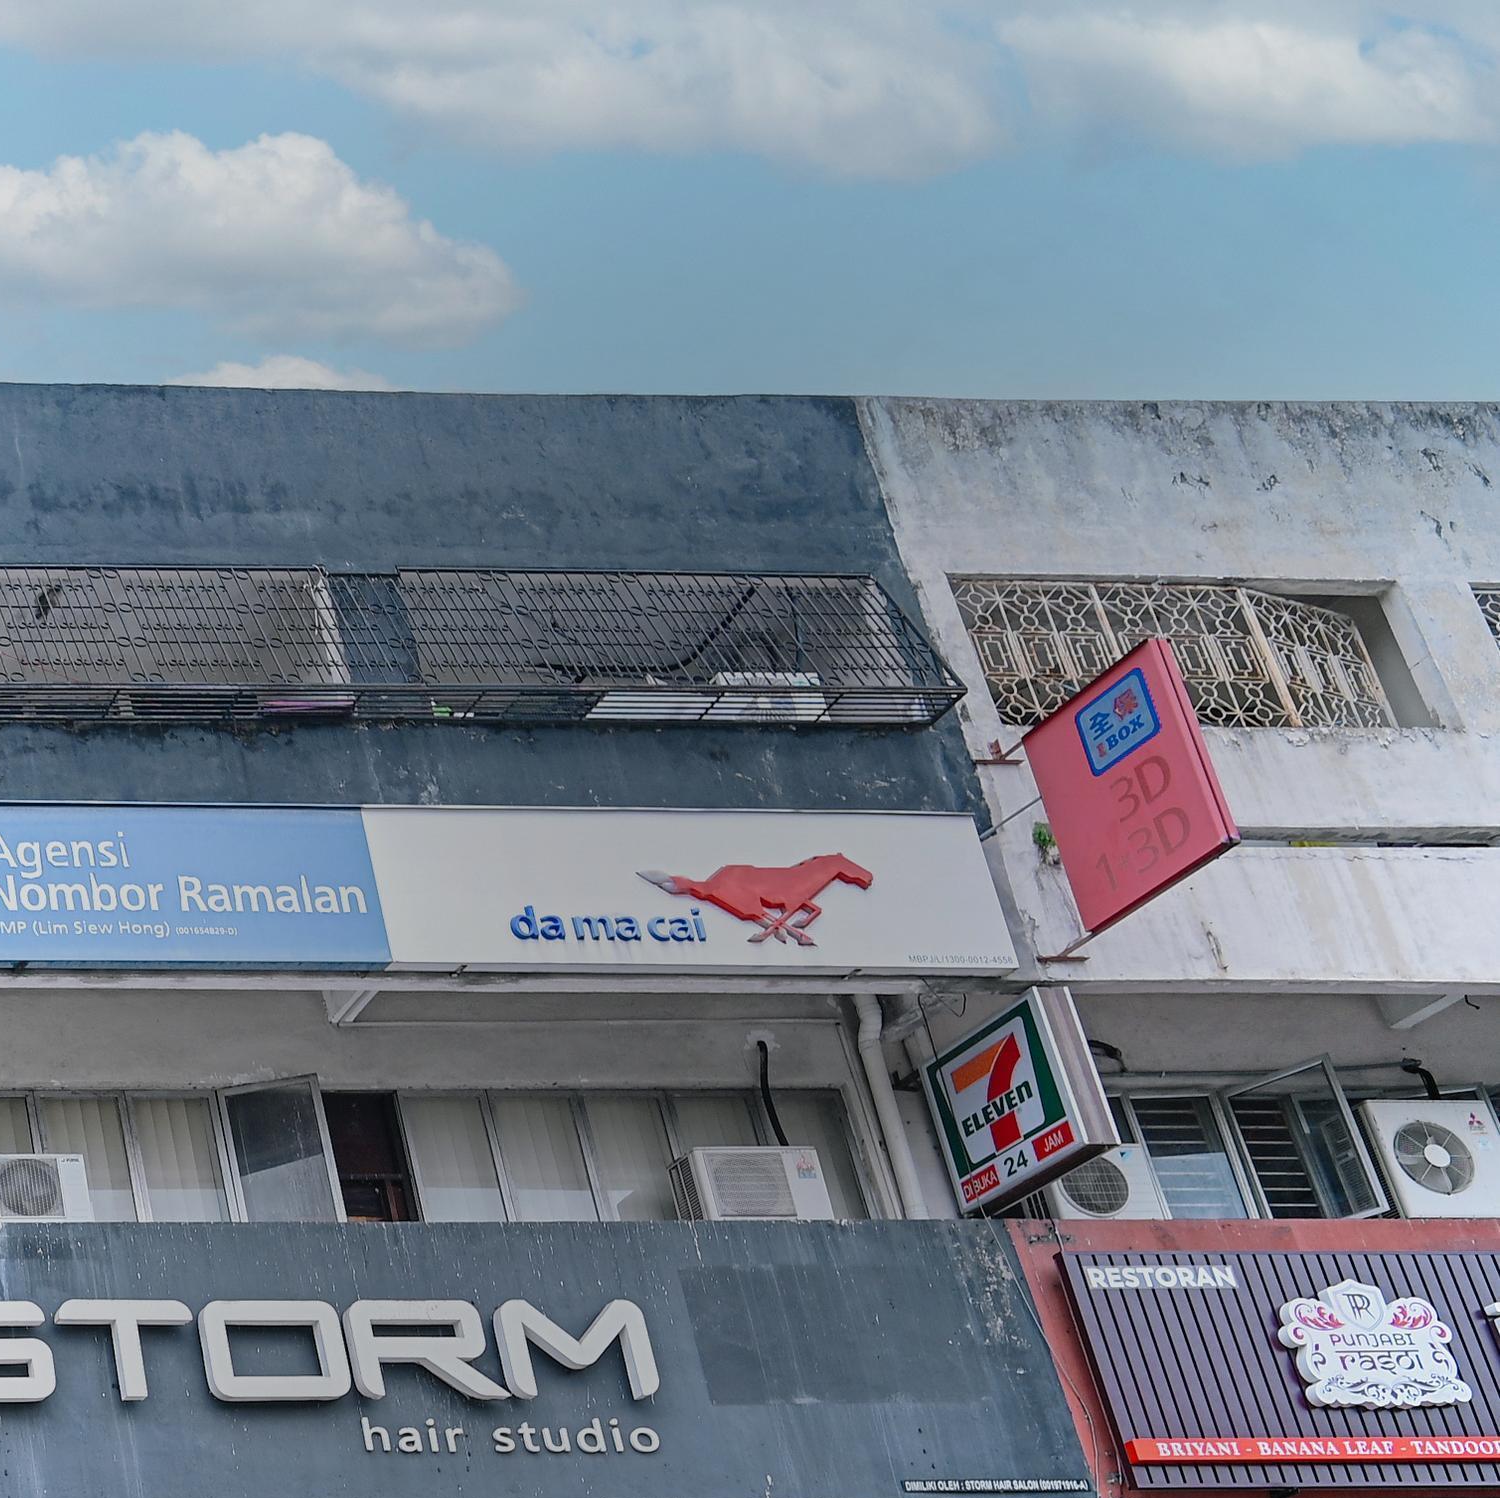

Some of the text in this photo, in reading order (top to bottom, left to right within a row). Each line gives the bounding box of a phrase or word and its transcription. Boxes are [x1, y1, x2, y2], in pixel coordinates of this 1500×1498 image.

[1110, 755, 1171, 823] 3D
[178, 875, 368, 914] Ramalan
[33, 921, 71, 938] (Lim
[74, 920, 114, 936] Siew
[120, 919, 171, 938] Hong)
[1003, 1149, 1029, 1178] 24
[1043, 1131, 1064, 1153] JAM
[1086, 1265, 1238, 1290] RESTORAN
[1329, 1332, 1416, 1348] PUNJABI
[361, 1416, 662, 1454] hair studio
[1156, 1441, 1241, 1457] BRIYANI
[1258, 1441, 1338, 1456] BANANA
[1342, 1440, 1394, 1455] LEAF
[1012, 1480, 1039, 1490] SALON
